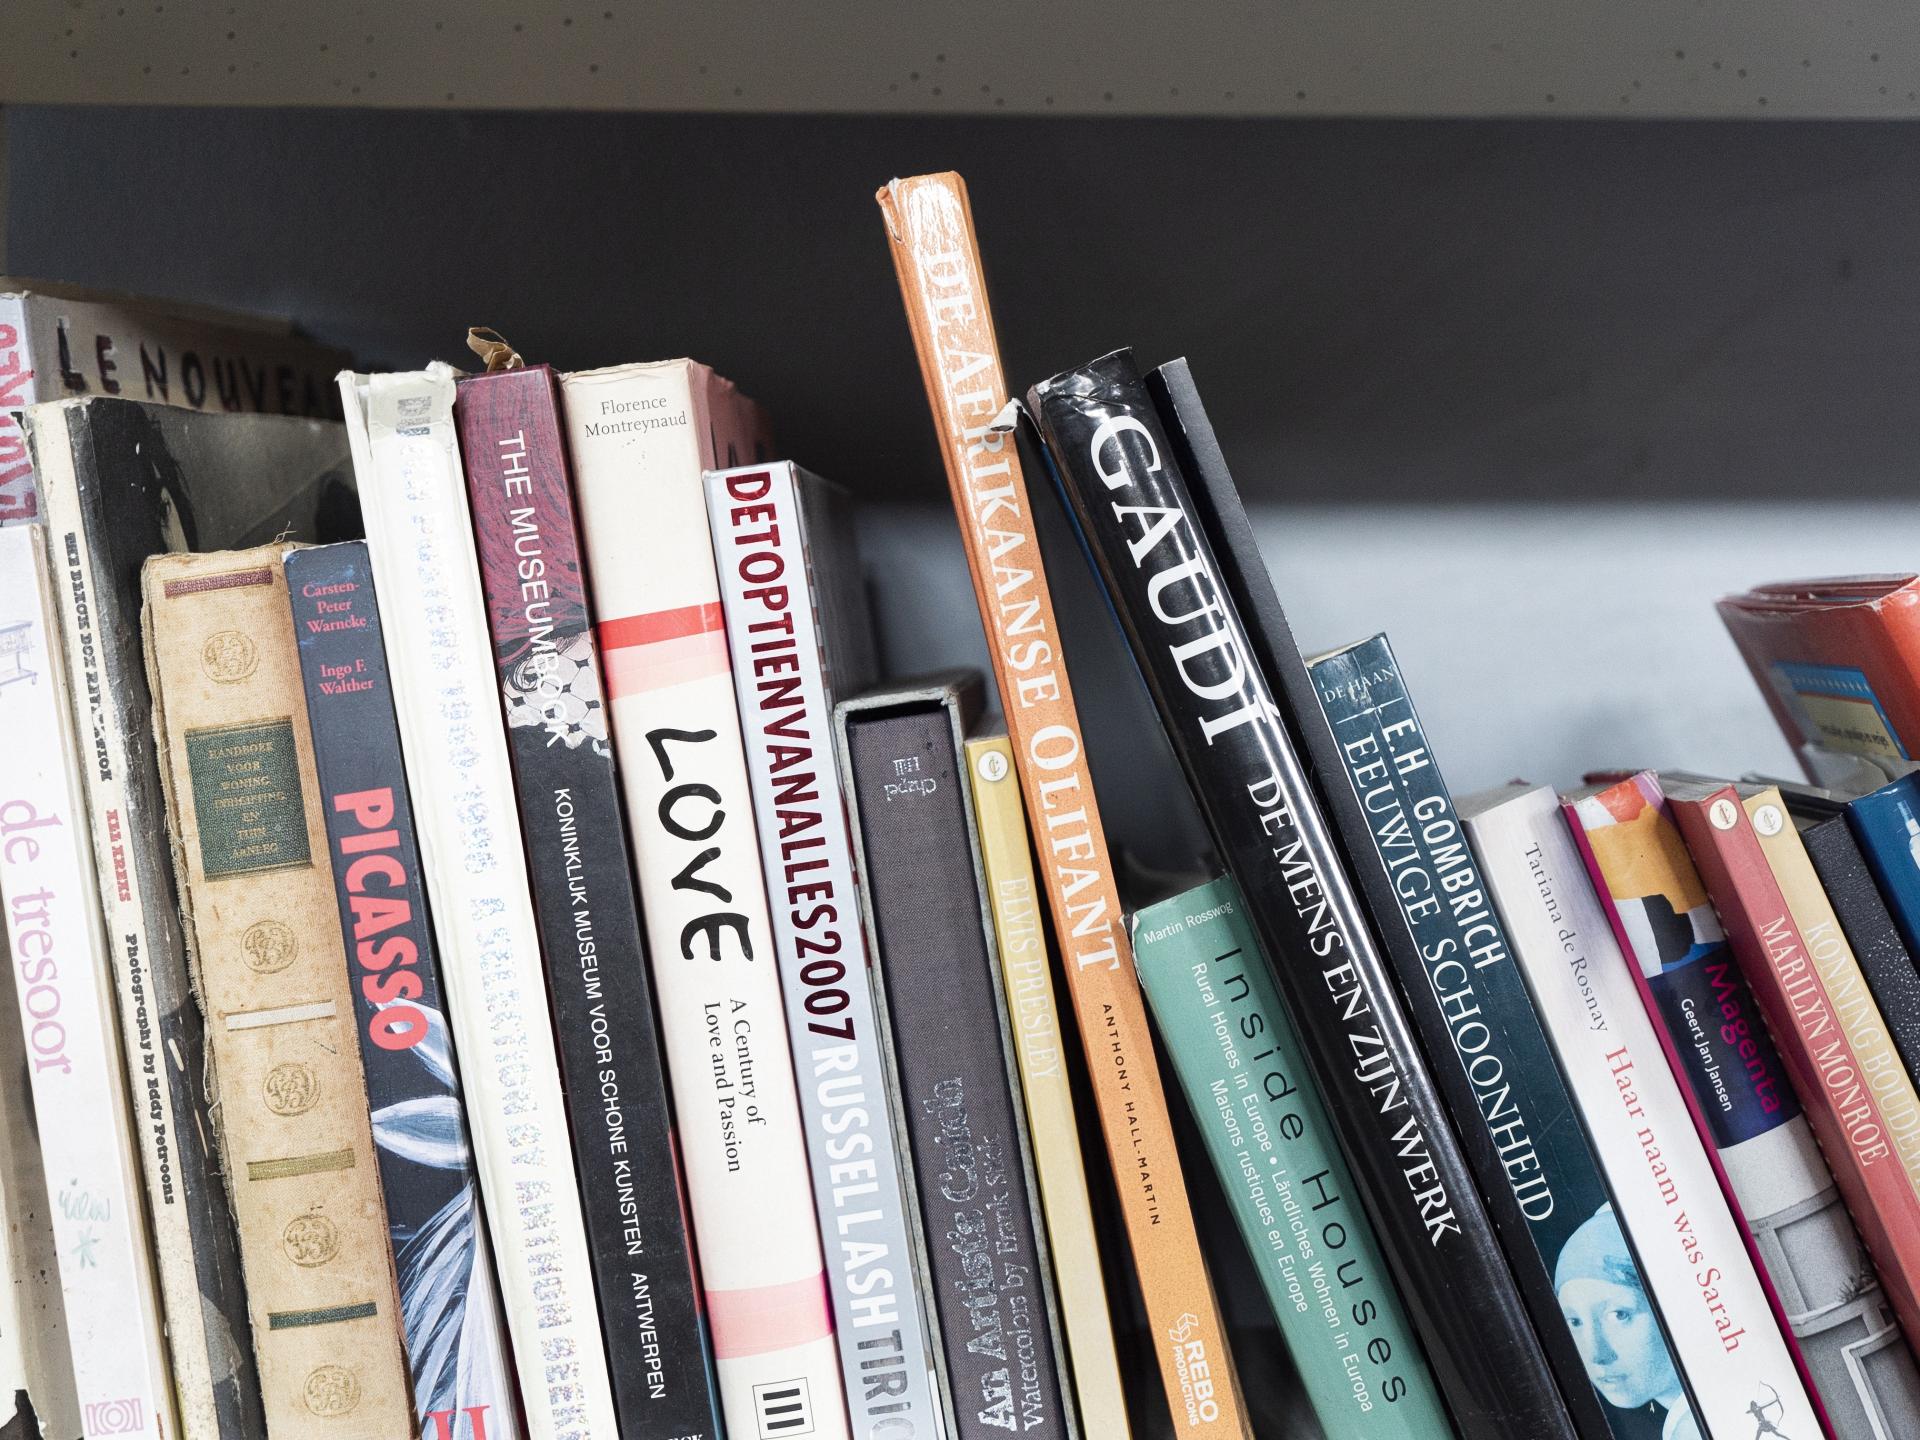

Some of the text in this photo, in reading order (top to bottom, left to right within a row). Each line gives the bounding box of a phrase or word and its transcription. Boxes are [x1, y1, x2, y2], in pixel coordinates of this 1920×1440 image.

[498, 429, 533, 497] THE
[584, 411, 687, 437] Montreynaud
[601, 397, 667, 415] Florence
[64, 531, 80, 566] THE
[80, 632, 97, 669] BOX
[303, 581, 360, 598] Carsten-
[307, 614, 367, 633] Warncke
[317, 599, 353, 614] Peter
[947, 347, 1061, 709] AFRIKAANSE
[1030, 724, 1120, 973] OLIFANT
[319, 678, 375, 696] Walther
[320, 659, 367, 680] Ingo F.
[1324, 666, 1395, 703] DE HAAN
[645, 728, 754, 962] LOVE
[1413, 796, 1506, 970] GOMBRICH
[0, 799, 72, 1075] de tresoor
[333, 786, 430, 1051] PICASSO
[1000, 877, 1062, 1082] ELVIS PRESLEY
[1143, 901, 1234, 945] Martin Rosswog
[1344, 732, 1554, 1221] EEUWIGE SCHOONHEID
[125, 934, 174, 1205] Photography by Eddy Petroons
[730, 998, 767, 1126] A Century of
[1247, 774, 1462, 1247] DE MENS EN ZIJN WERK
[1681, 998, 1733, 1112] Geert Jan Jansen
[1705, 962, 1781, 1114] Magenta
[1759, 913, 1890, 1167] MARILYN MONROE
[554, 788, 667, 1400] KONINKLIJK MUSEUM VOOR SCHONE KUNSTEN ANTWERPEN
[704, 1001, 742, 1172] Love and Passion
[1102, 1003, 1160, 1226] ANTHONY HALL-MARTIN
[1525, 842, 1746, 1354] Tatiana de Rosnay Haar naam was Sarah
[1191, 961, 1373, 1414] Rural Homes in Europe Ländliches Wohnen in Europa
[1210, 1078, 1309, 1313] Maisons rustiques en Europe
[1215, 947, 1407, 1403] Inside Houses
[1000, 1262, 1029, 1291] by
[977, 1367, 1018, 1432] An
[1007, 1295, 1045, 1432] Watercolors
[1172, 1345, 1200, 1426] PRODUCTIONS
[1184, 1339, 1218, 1424] REBO
